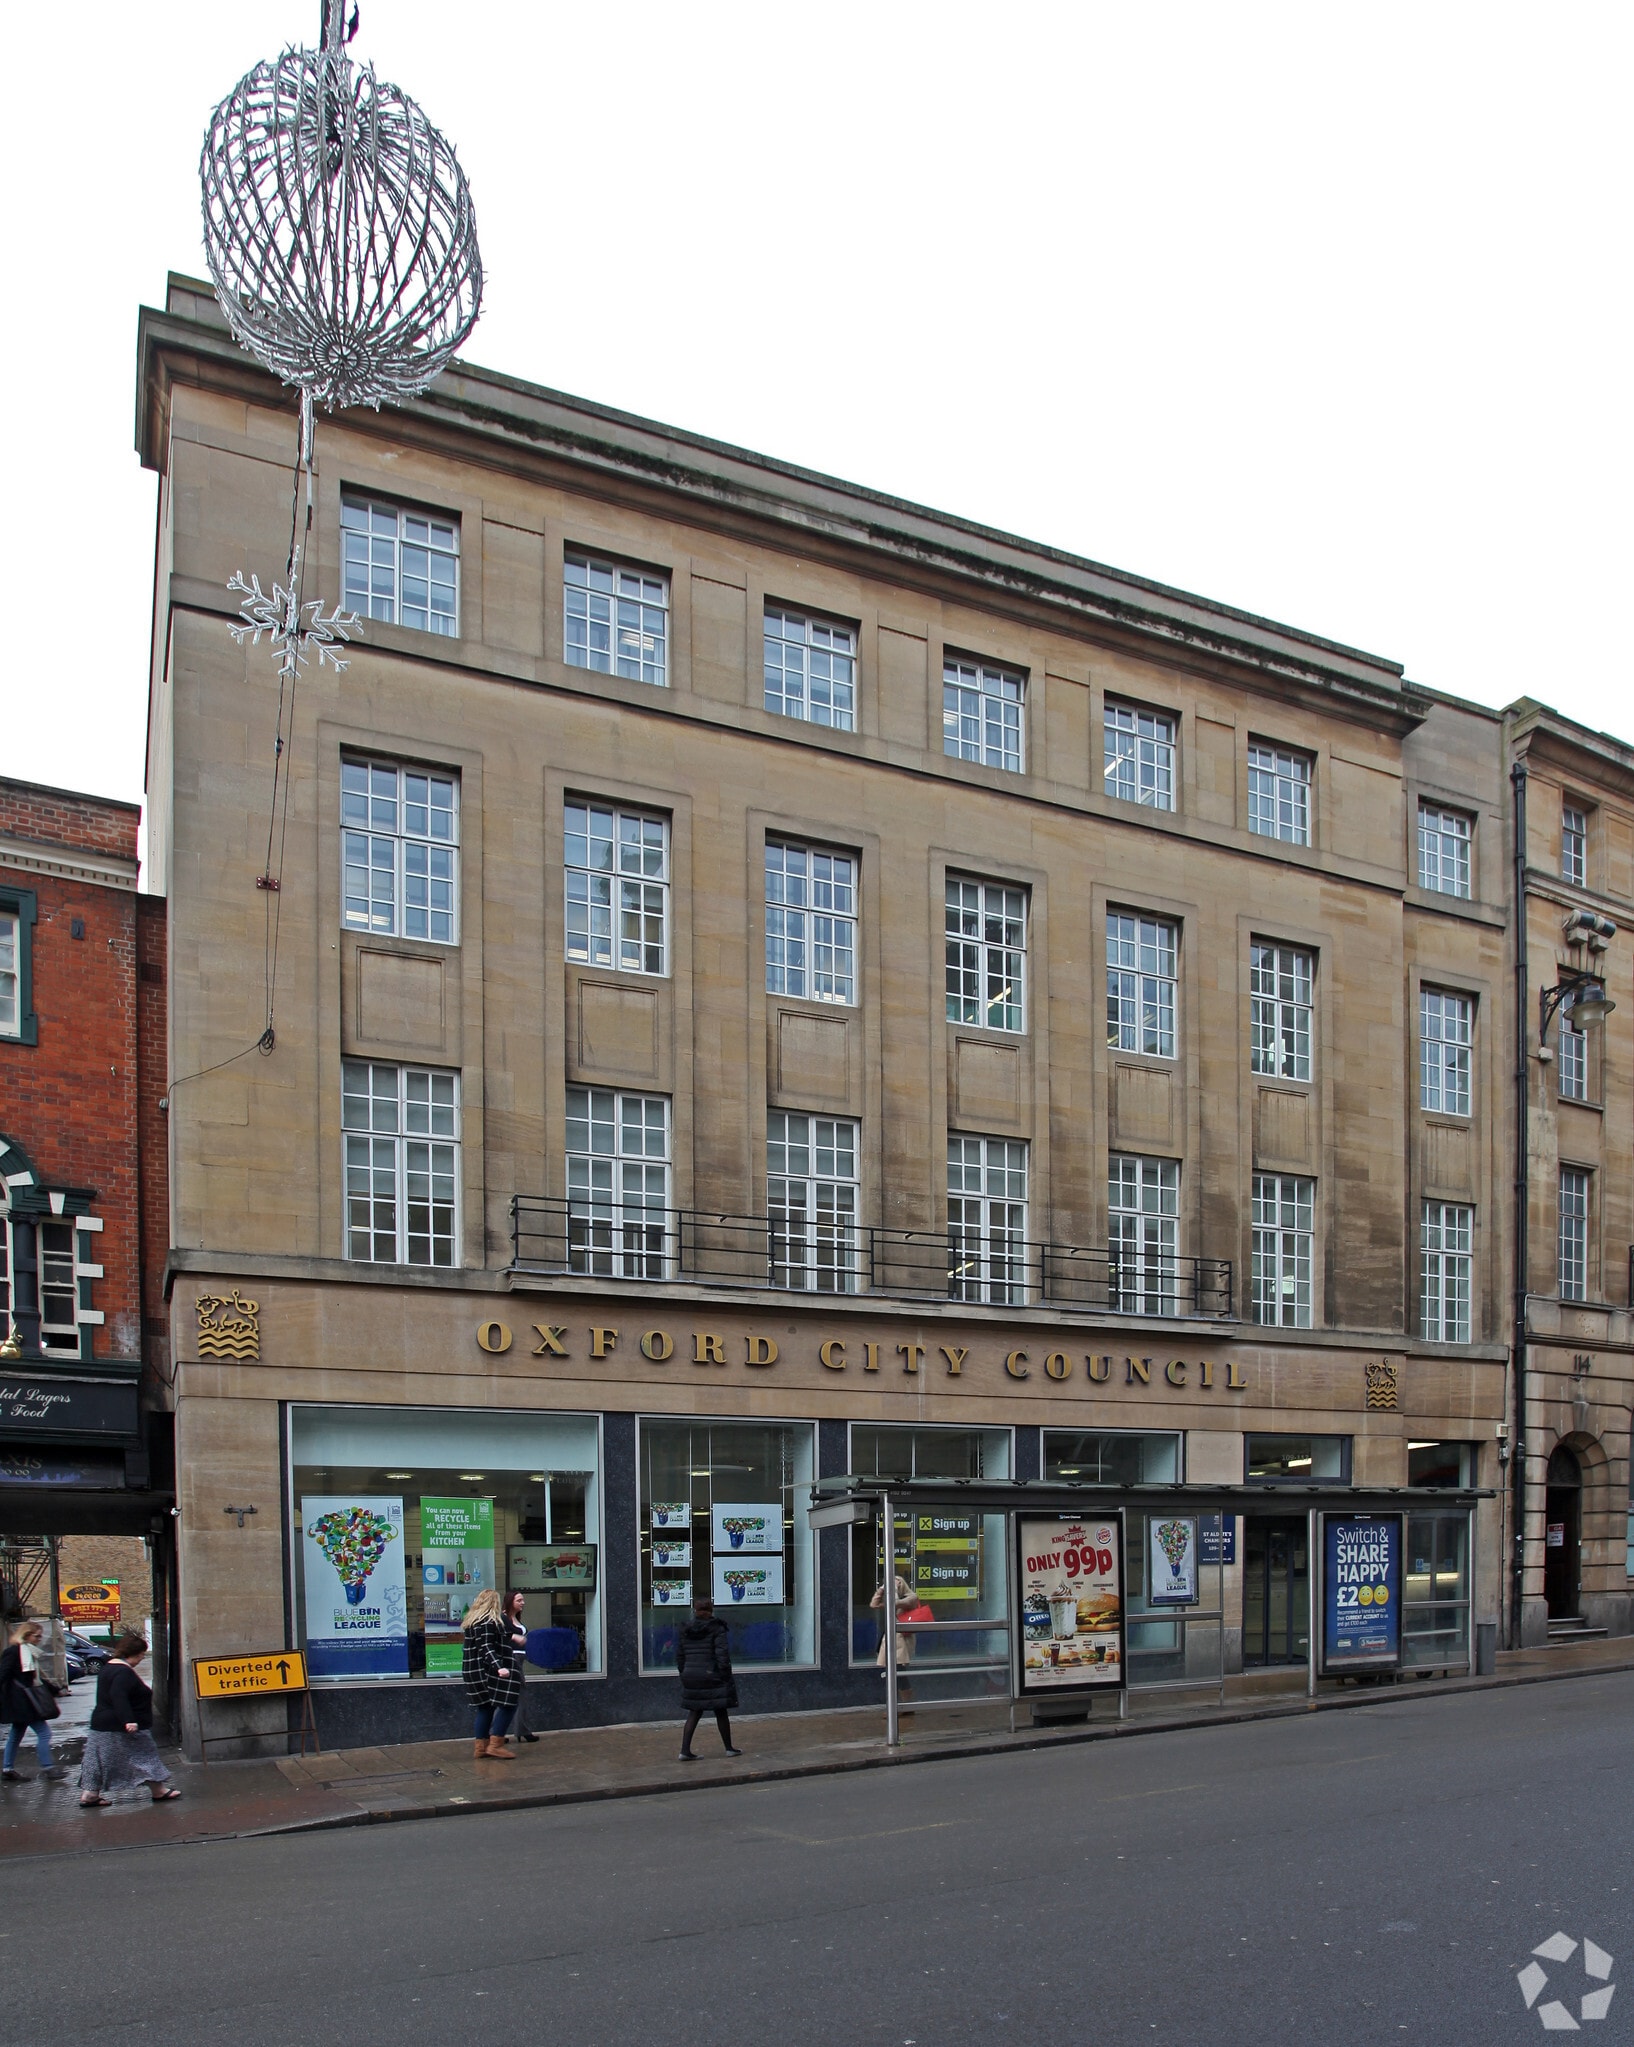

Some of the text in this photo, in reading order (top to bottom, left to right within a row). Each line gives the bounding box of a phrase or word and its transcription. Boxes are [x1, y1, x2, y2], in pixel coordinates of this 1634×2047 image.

[475, 1320, 1249, 1388] OXFORD CITY COUNCIL
[1573, 1354, 1591, 1371] 114
[25, 1388, 71, 1407] Lagers
[11, 1403, 49, 1417] Food
[434, 1514, 470, 1523] RECYCLE
[933, 1518, 970, 1531] Sign up
[429, 1537, 465, 1546] KITCHEN
[1336, 1526, 1389, 1544] Switch &
[1063, 1546, 1113, 1578] 99p
[1336, 1544, 1389, 1564] SHARE
[1026, 1552, 1061, 1573] ONLY
[932, 1568, 968, 1580] Sign up
[1337, 1564, 1390, 1583] HAPPY
[334, 1621, 381, 1629] LEAGUE
[208, 1660, 273, 1676] Diverted
[219, 1676, 268, 1689] traffic
